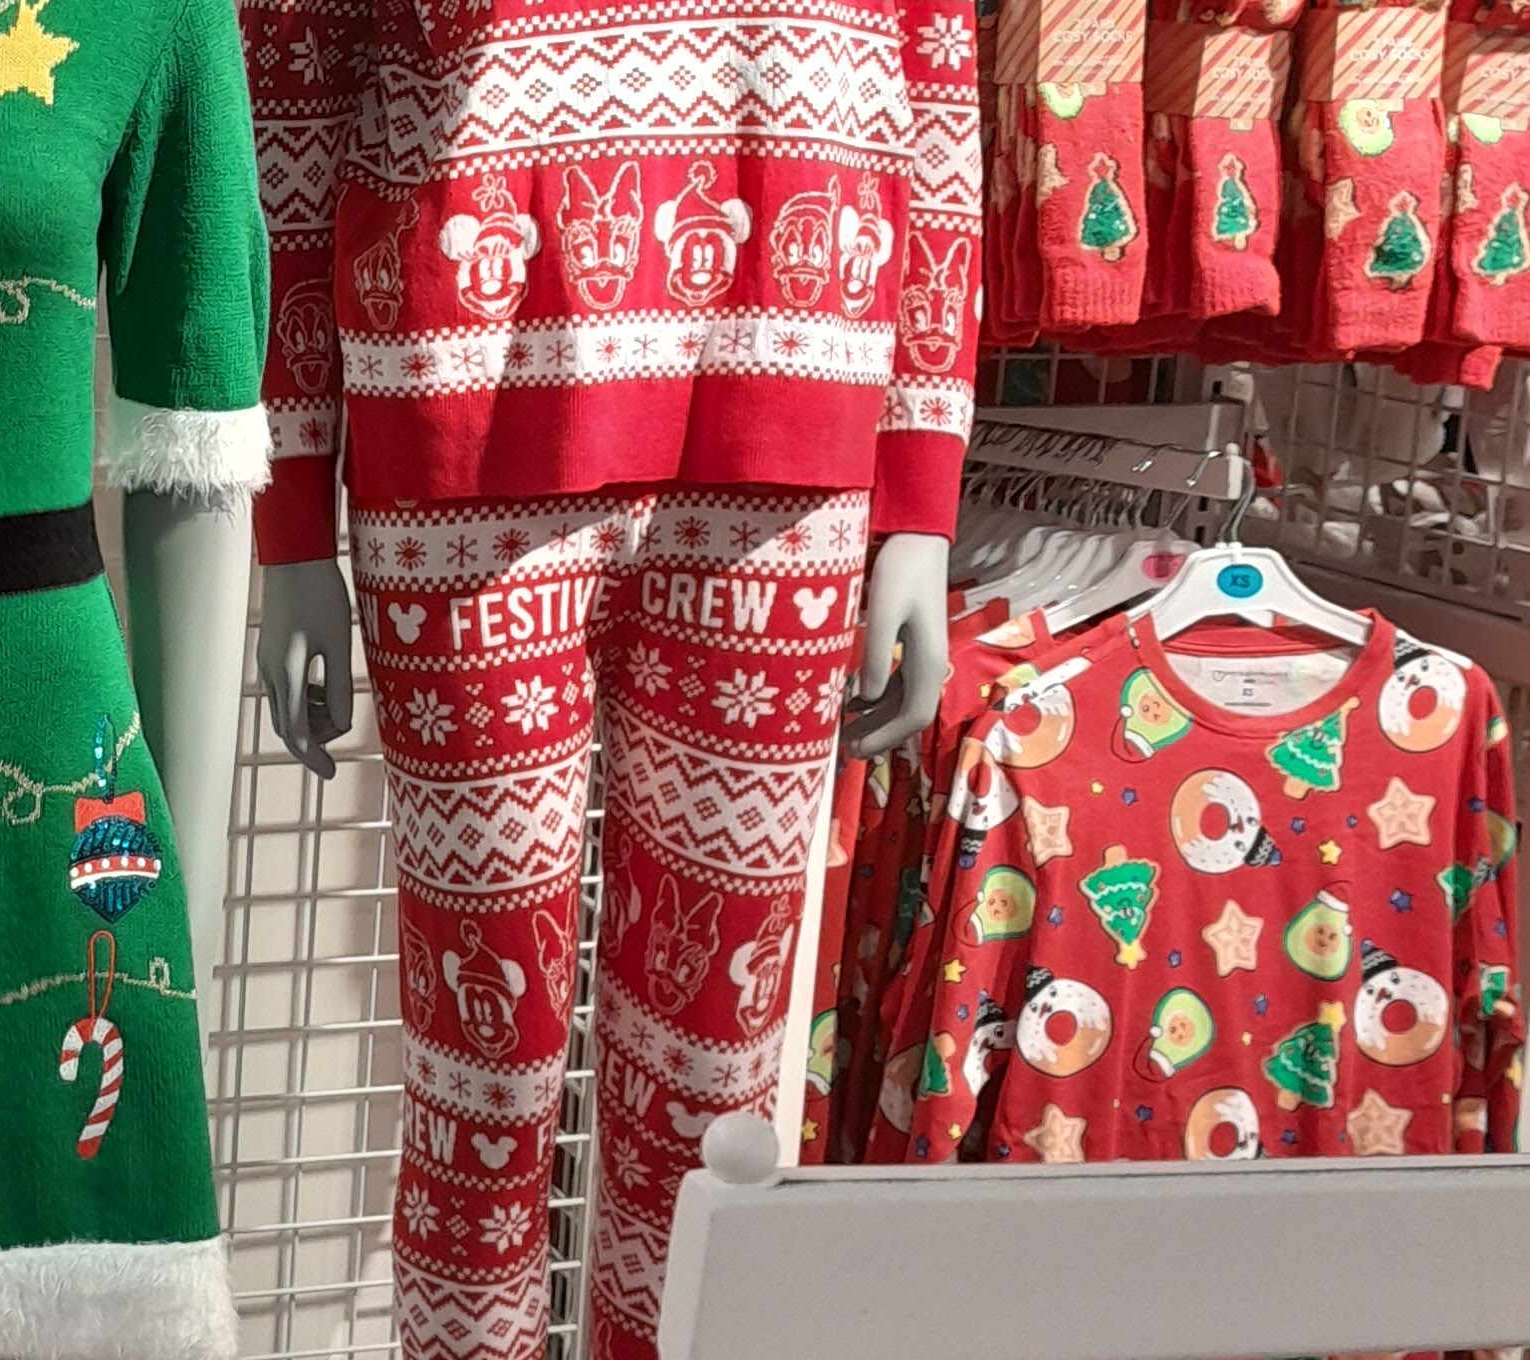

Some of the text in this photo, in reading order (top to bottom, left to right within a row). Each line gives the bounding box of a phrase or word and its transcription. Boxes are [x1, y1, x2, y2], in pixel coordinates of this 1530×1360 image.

[1228, 573, 1252, 589] XS
[448, 574, 622, 650] FESTIVE
[641, 570, 778, 634] CREW
